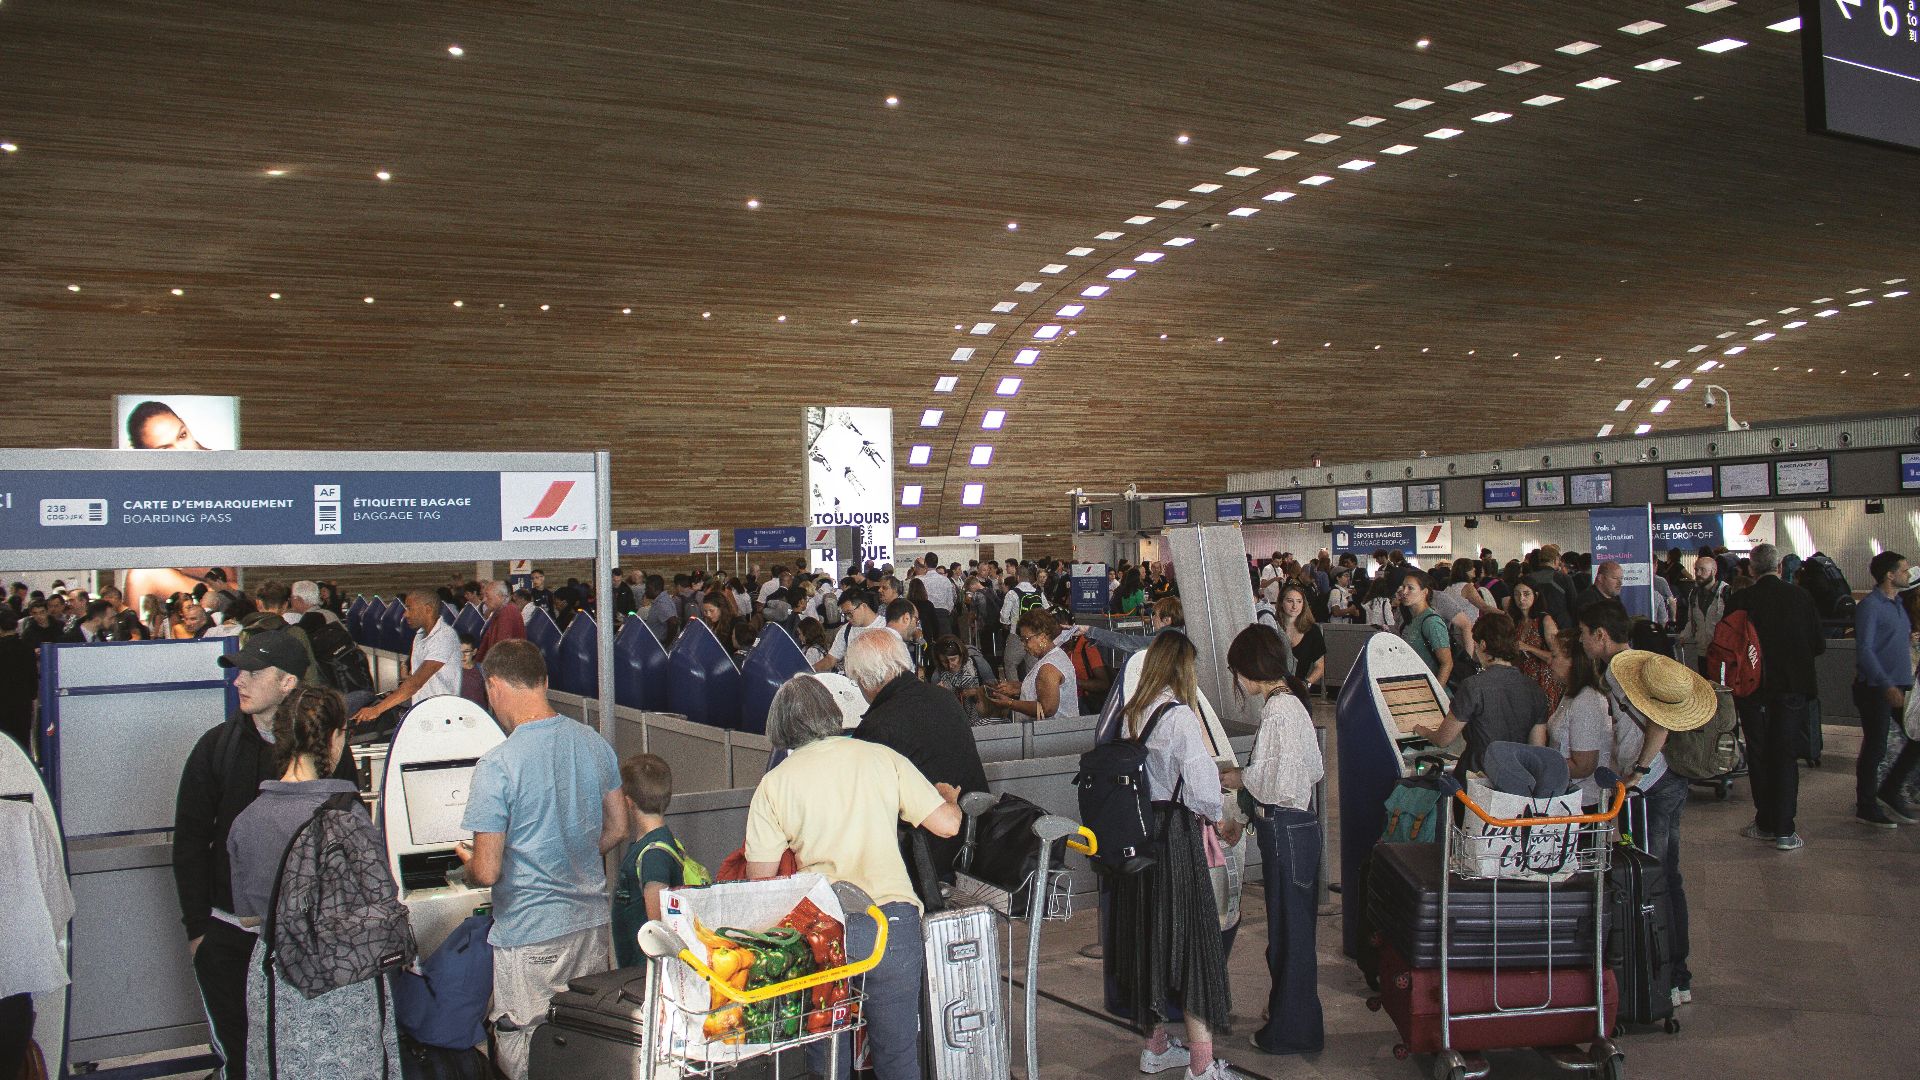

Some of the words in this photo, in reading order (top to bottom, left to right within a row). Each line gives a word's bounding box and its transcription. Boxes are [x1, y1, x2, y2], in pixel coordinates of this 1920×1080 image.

[1879, 0, 1898, 37] 6
[320, 488, 336, 497] AF
[123, 500, 168, 510] CARTE
[173, 499, 294, 510] D'EMBARQUEMENT
[353, 496, 417, 508] ÉTIQUETTE
[421, 497, 472, 507] BAGAGE
[123, 515, 195, 524] BOARDING
[201, 513, 232, 523] PASS
[354, 511, 412, 521] BAGGAGE
[418, 510, 441, 520] TAG
[814, 512, 889, 525] TOUJOURS
[1080, 511, 1087, 526] 4
[319, 522, 336, 532] JFK
[512, 525, 569, 534] AIRFRANCE
[1663, 522, 1703, 531] BAGAGES
[1672, 531, 1713, 540] DROP-OFF
